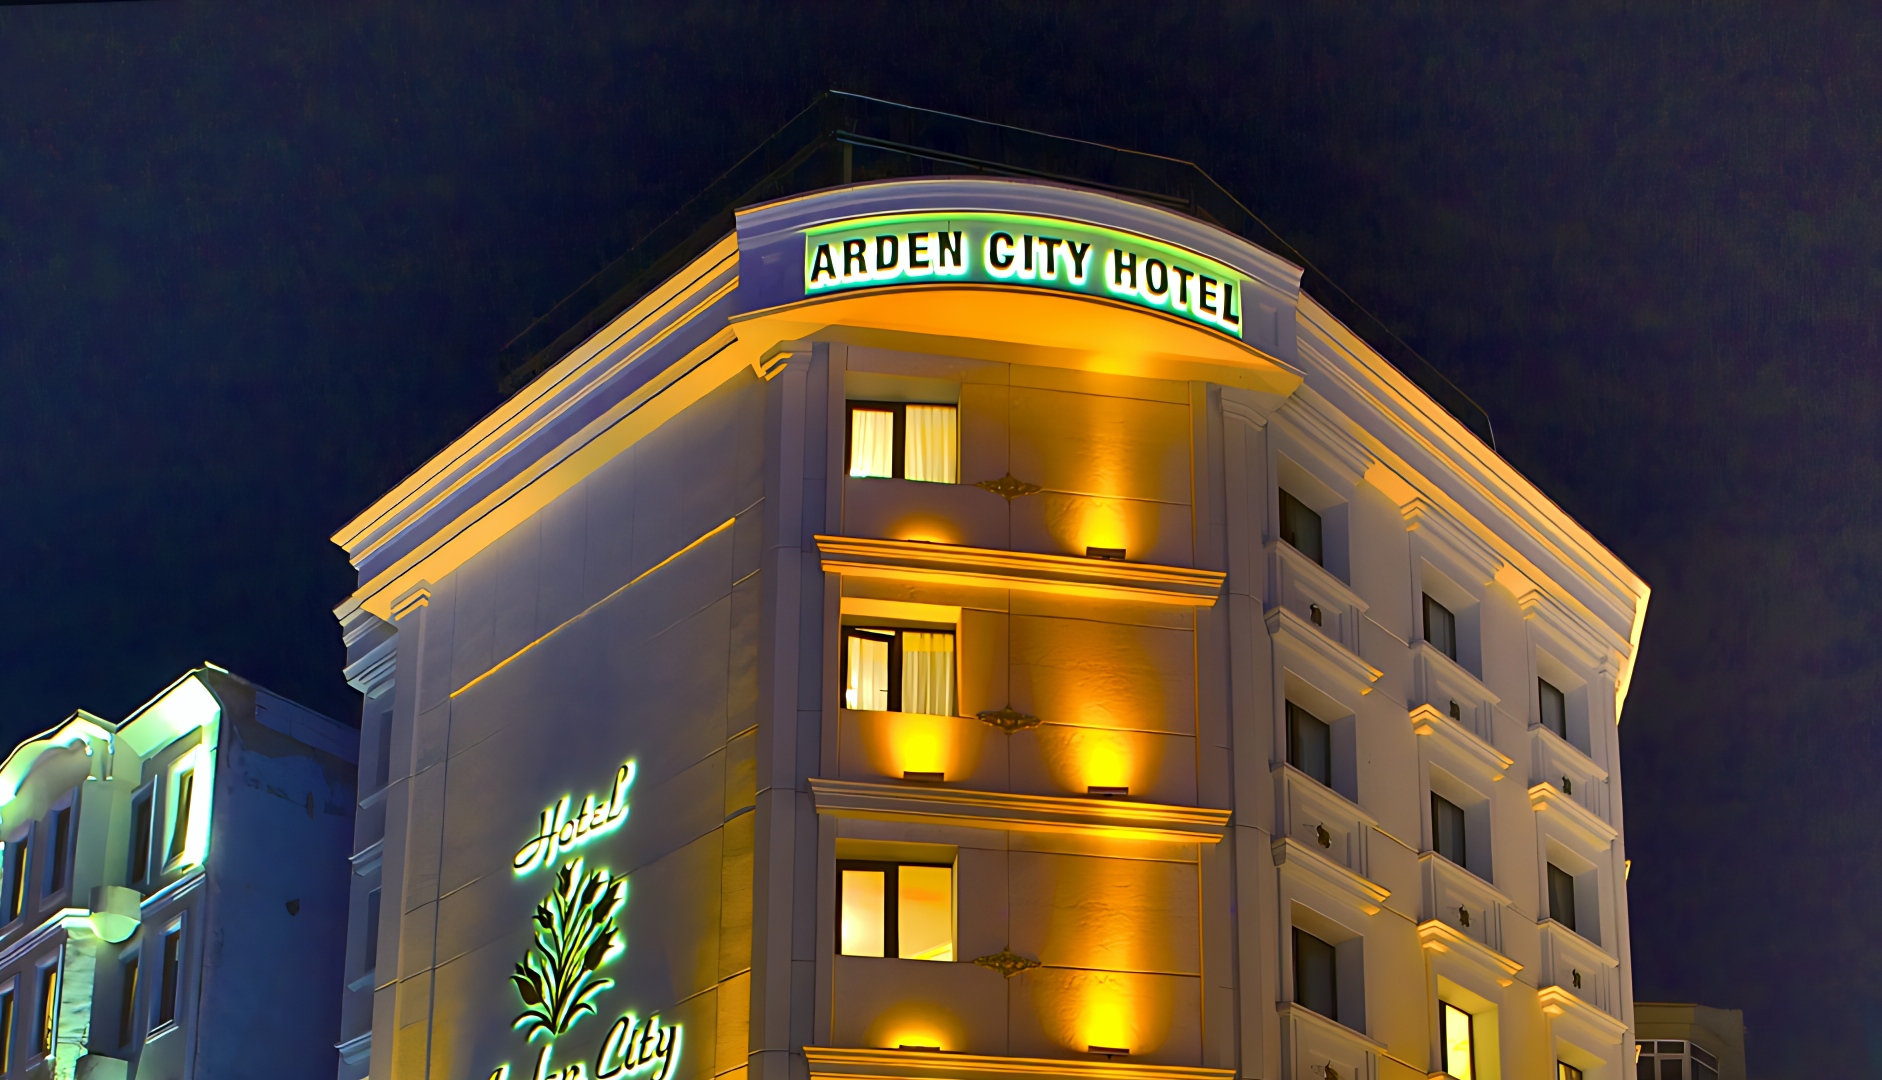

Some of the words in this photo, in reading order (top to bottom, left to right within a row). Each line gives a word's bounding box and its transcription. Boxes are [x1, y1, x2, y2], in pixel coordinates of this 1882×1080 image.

[811, 230, 963, 283] ARDEN
[989, 231, 1091, 279] CITY
[1113, 248, 1240, 325] HOTEL
[512, 762, 634, 871] Hotel
